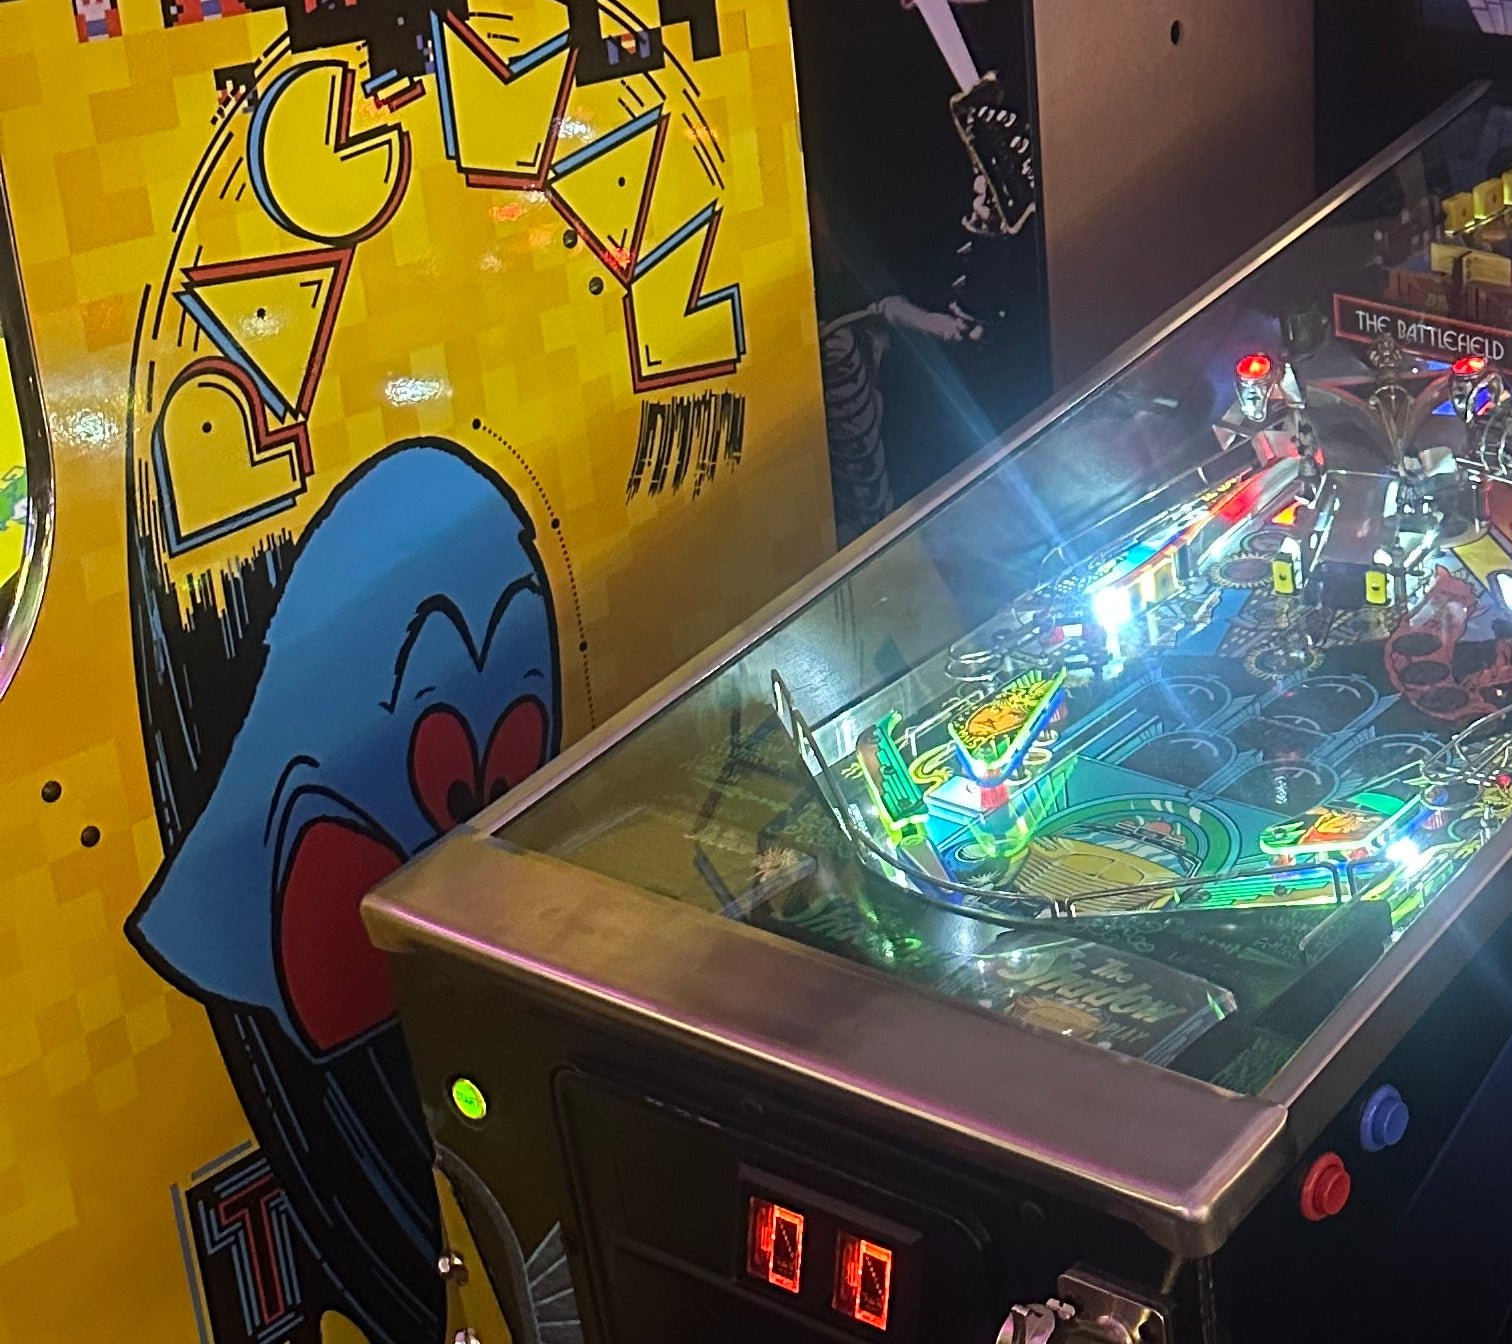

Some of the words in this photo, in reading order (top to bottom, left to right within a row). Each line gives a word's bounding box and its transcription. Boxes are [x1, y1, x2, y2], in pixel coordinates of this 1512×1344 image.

[1355, 310, 1392, 333] THE
[1397, 319, 1505, 361] BATTLEFIELD
[1091, 957, 1134, 984] The
